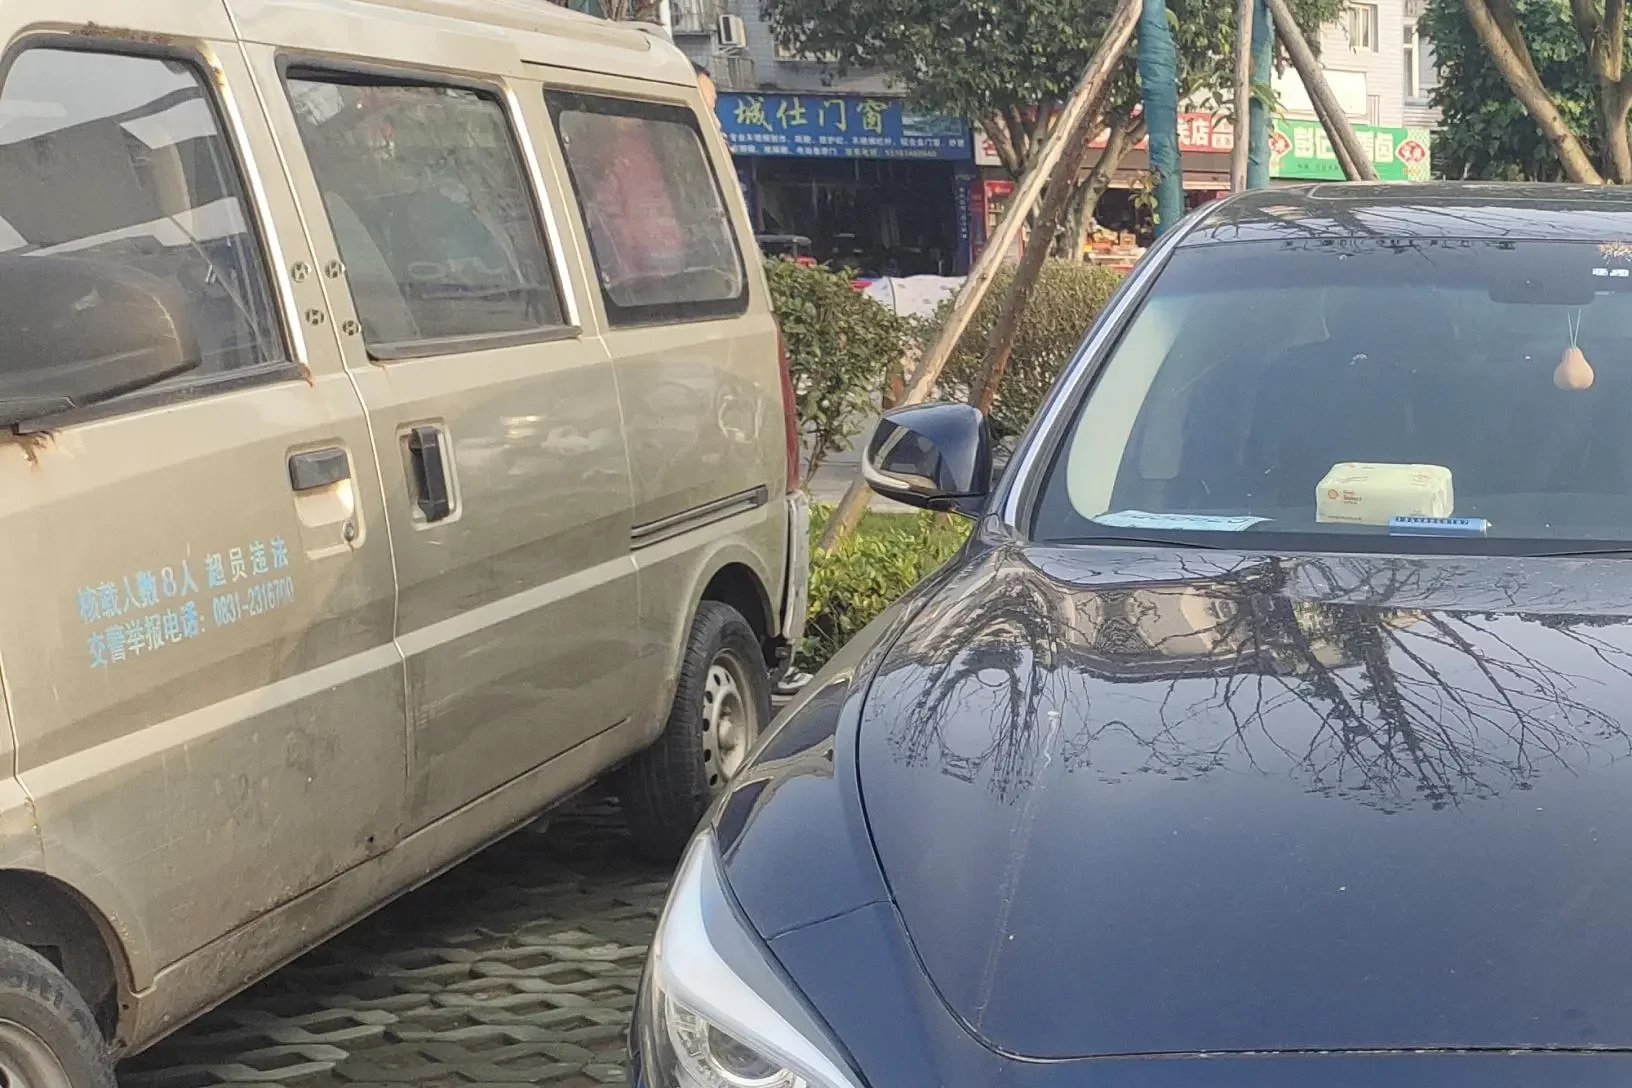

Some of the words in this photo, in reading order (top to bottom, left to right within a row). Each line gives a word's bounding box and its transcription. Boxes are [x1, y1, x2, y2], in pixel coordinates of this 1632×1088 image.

[734, 96, 889, 134] 城仕门窗
[205, 536, 289, 588] 超员违法
